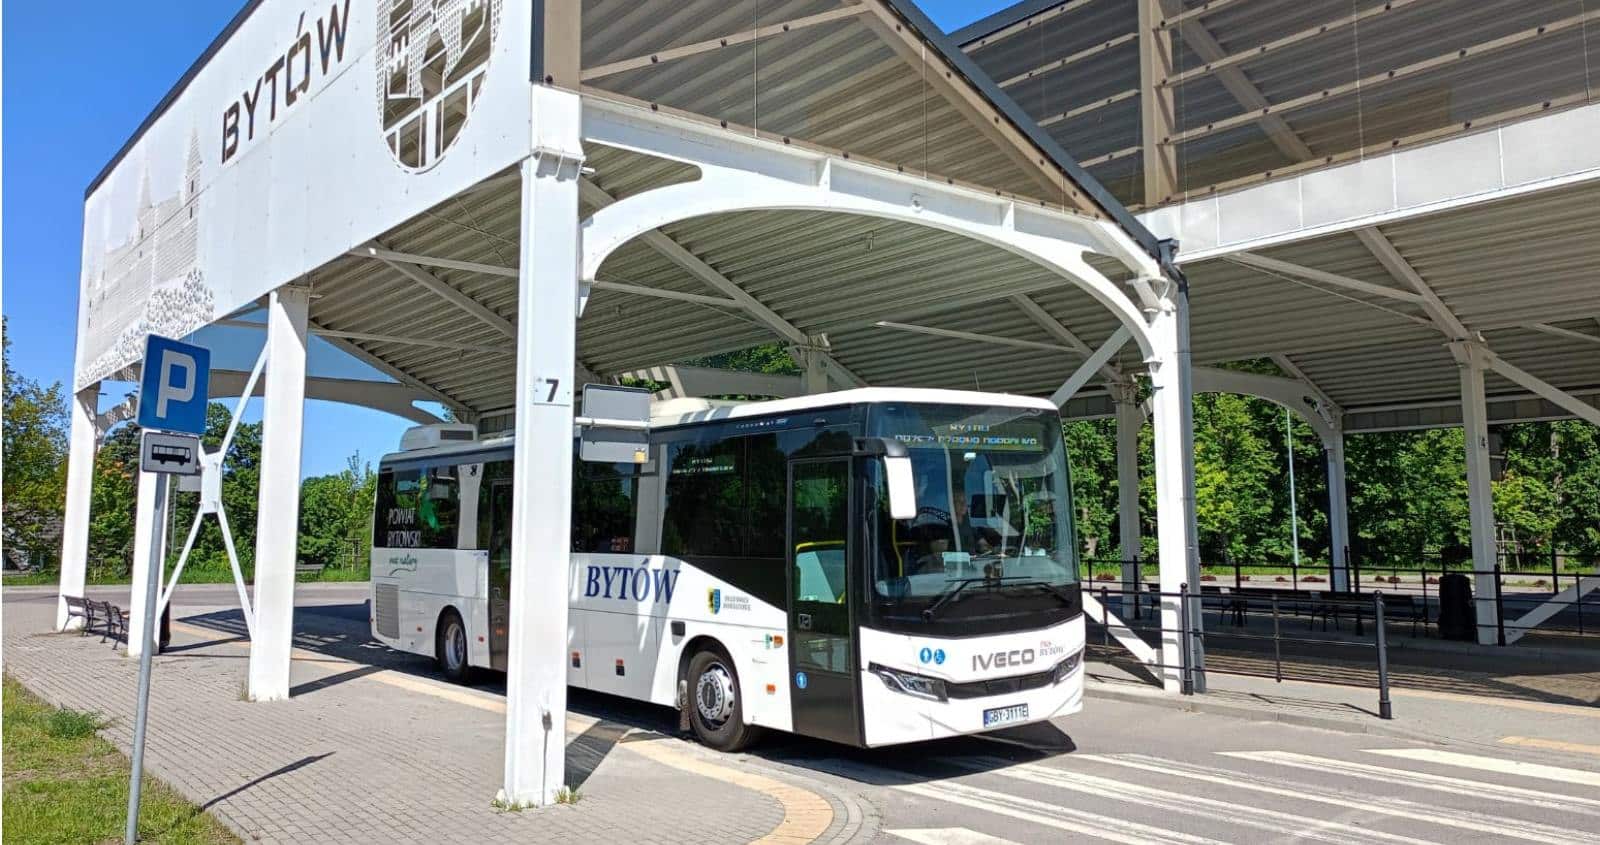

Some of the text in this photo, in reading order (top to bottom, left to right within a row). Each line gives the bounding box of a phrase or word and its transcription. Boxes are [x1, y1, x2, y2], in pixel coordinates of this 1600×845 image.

[221, 0, 350, 164] BYTÓW
[156, 349, 197, 419] P
[545, 378, 560, 402] 7
[388, 508, 416, 526] POWIAT
[584, 558, 681, 604] BYTÓW
[972, 648, 1035, 672] IVECO
